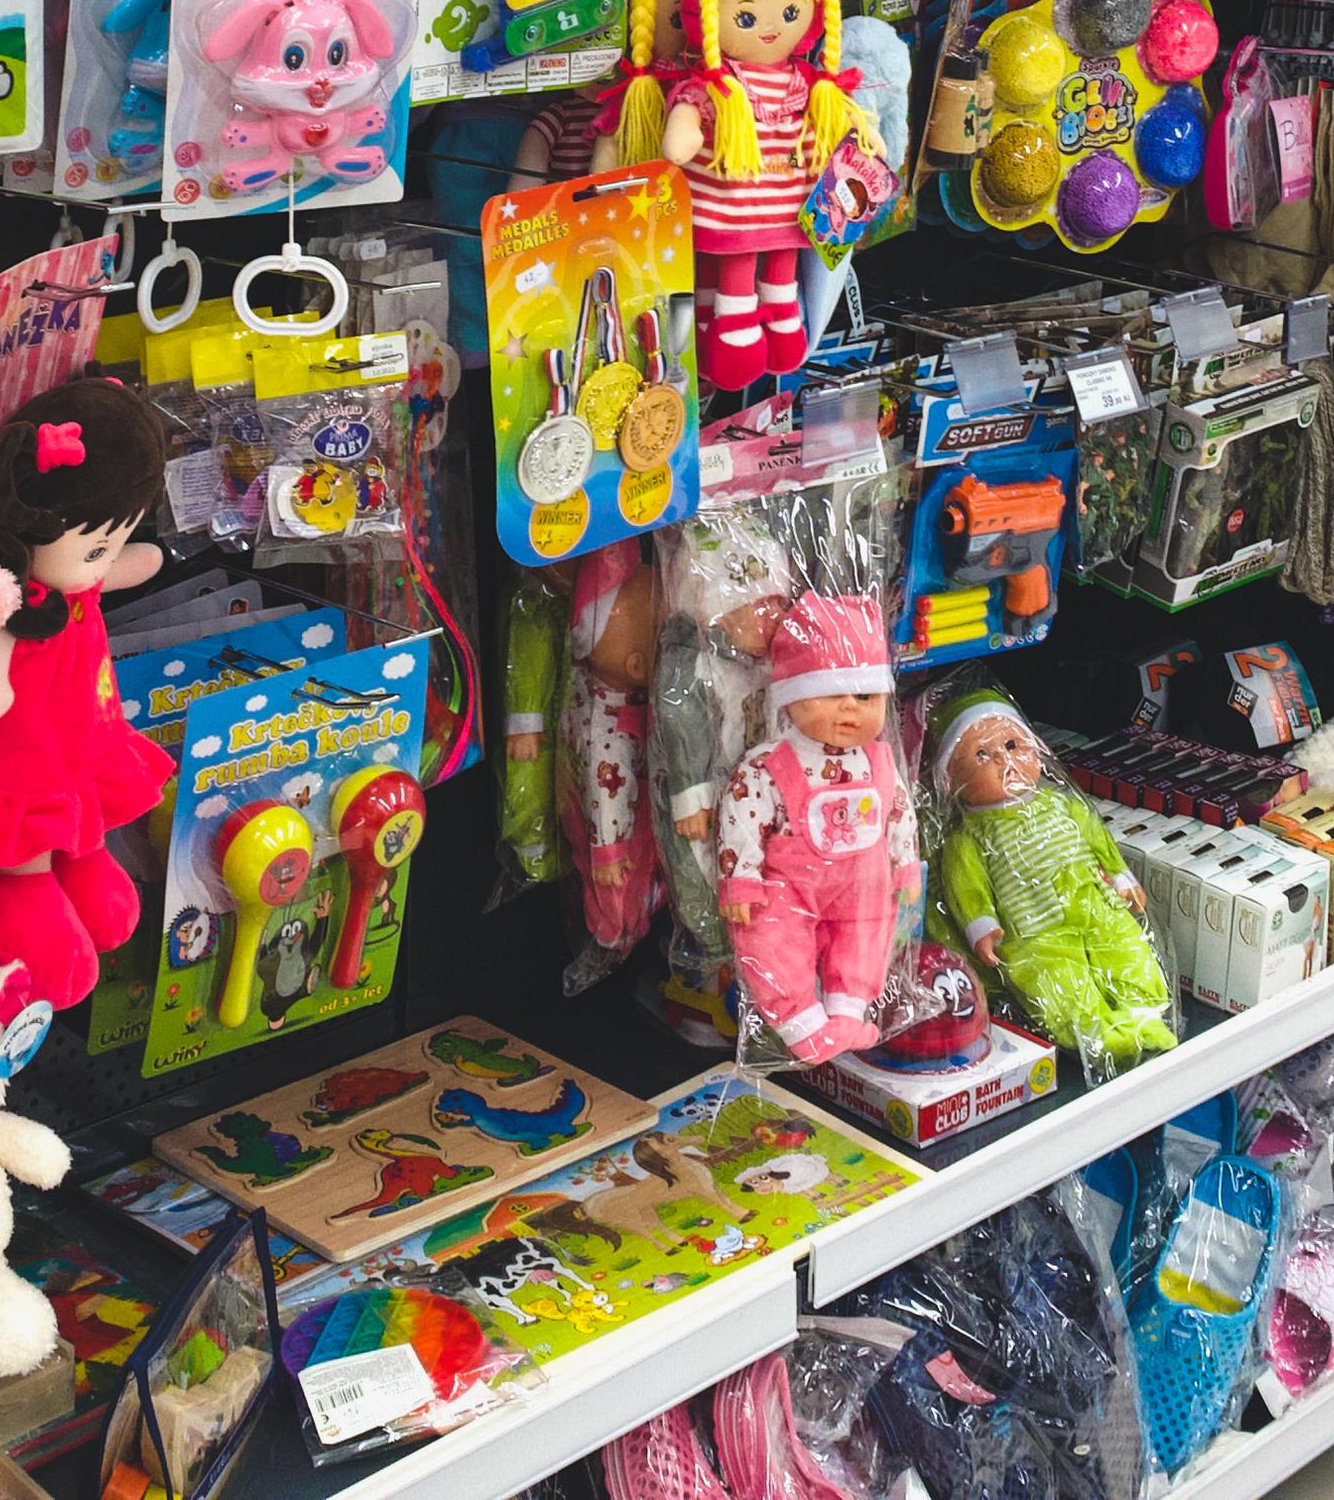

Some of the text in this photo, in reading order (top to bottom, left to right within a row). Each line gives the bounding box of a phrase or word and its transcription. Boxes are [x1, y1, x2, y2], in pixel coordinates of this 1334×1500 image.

[657, 174, 673, 204] 3
[500, 210, 559, 241] MEDALS
[491, 223, 570, 261] MEDAILLES
[324, 438, 365, 457] BABY
[946, 424, 994, 446] SOFT
[758, 454, 803, 472] PANENK
[626, 472, 667, 502] WINNER
[536, 509, 582, 526] WINNER
[1233, 645, 1288, 679] 2
[1233, 694, 1253, 711] der
[1234, 684, 1256, 701] nur
[228, 690, 386, 754] Krtečkovy
[193, 708, 412, 793] rumba koule
[319, 999, 338, 1014] od
[363, 985, 383, 999] let
[974, 1078, 1002, 1098] BATH
[975, 1084, 1025, 1116] FOUNTAIN
[934, 1109, 969, 1133] CLUB
